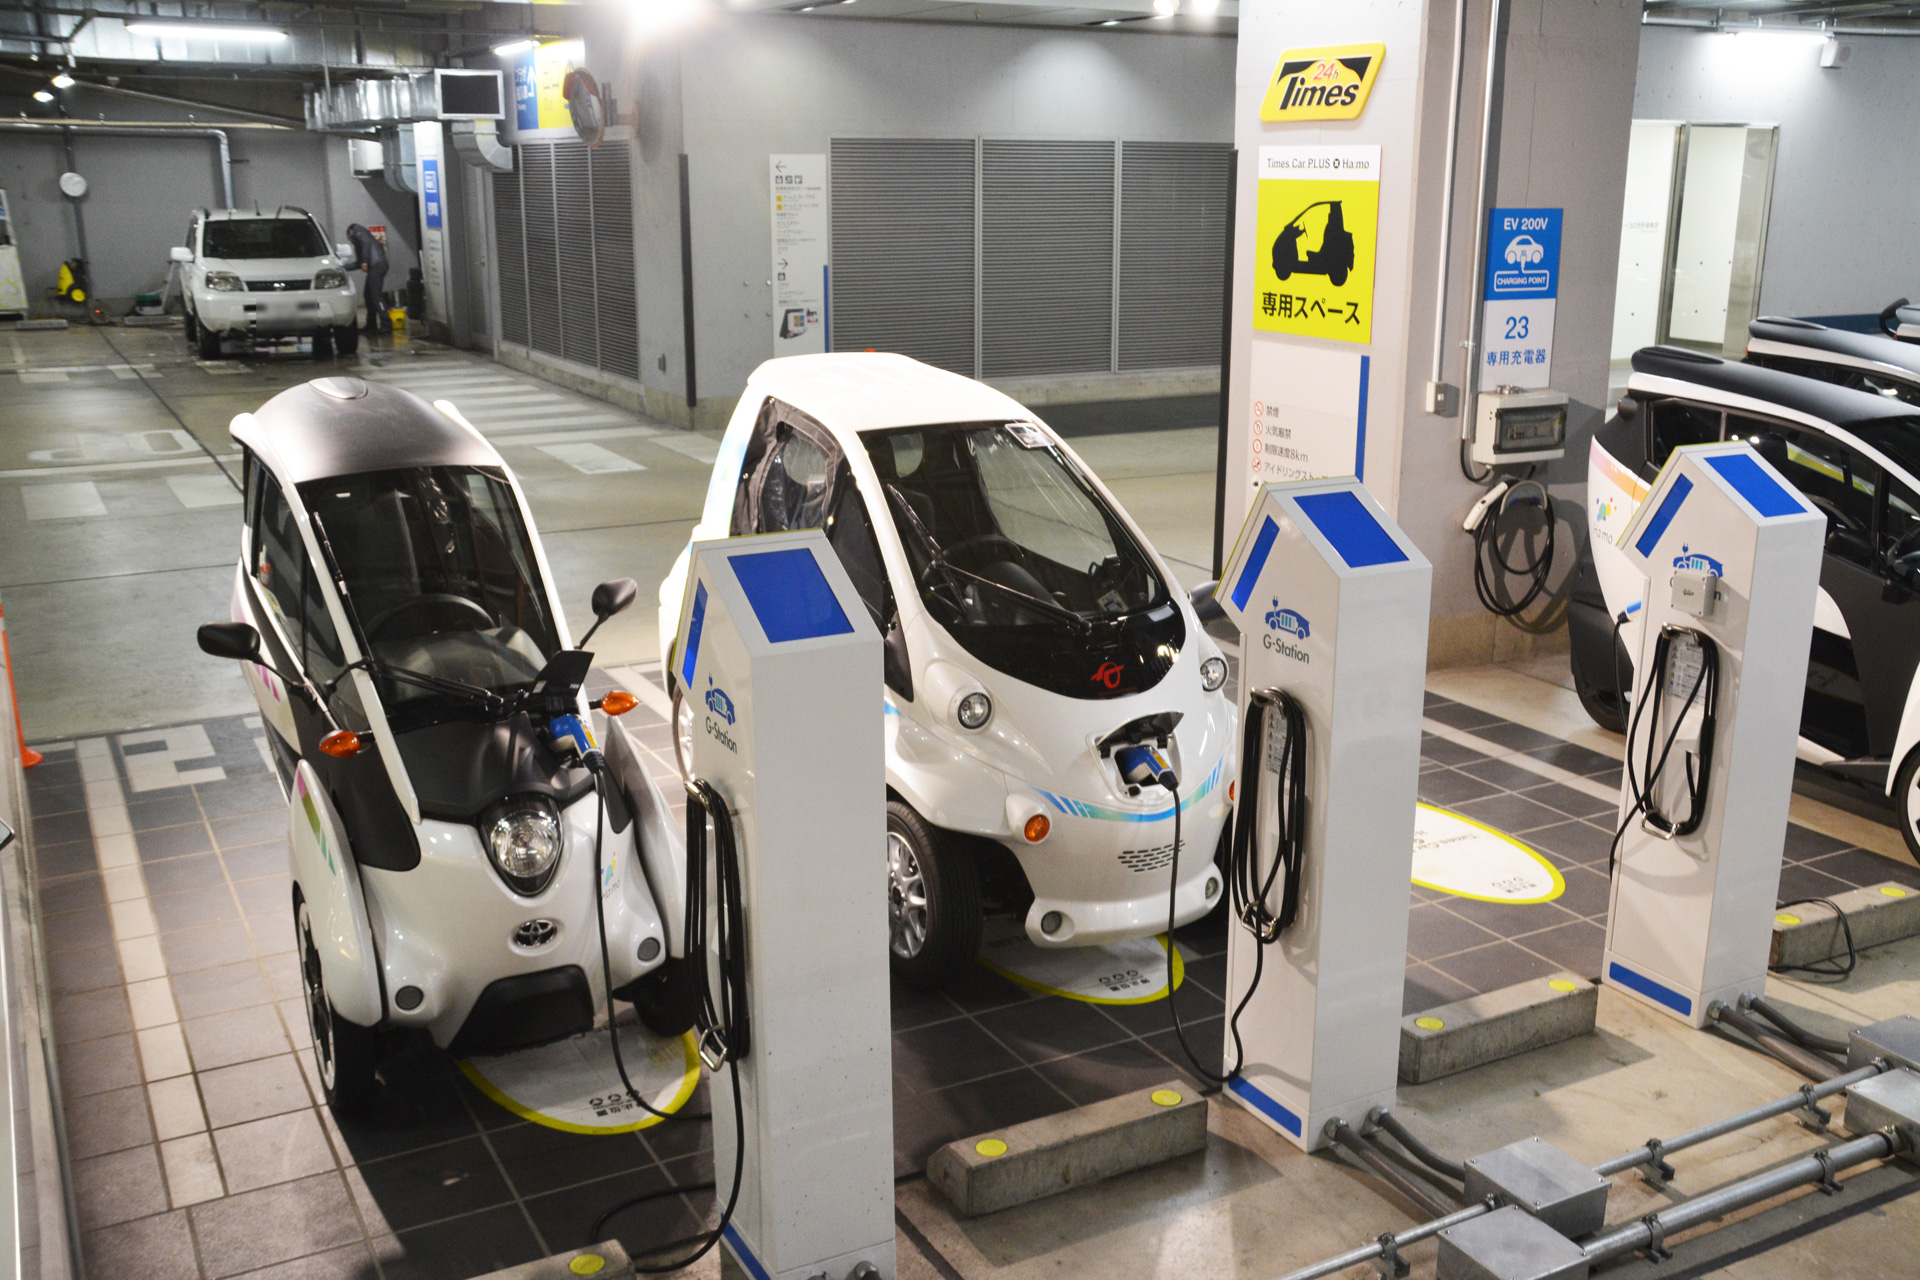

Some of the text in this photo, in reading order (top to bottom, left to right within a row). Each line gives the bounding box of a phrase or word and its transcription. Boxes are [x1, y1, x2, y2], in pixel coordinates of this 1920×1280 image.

[1279, 75, 1359, 111] Times
[1267, 157, 1290, 168] Times
[1291, 158, 1306, 169] Car
[1307, 158, 1331, 169] PLUS
[1503, 217, 1549, 231] EV 200V
[1496, 276, 1547, 286] CHARGING POINT
[1261, 291, 1360, 326] 専用スペース
[1504, 315, 1530, 340] 23
[1486, 349, 1547, 367] 専用充電器
[1263, 634, 1310, 665] G-Station
[705, 715, 738, 755] G-Station
